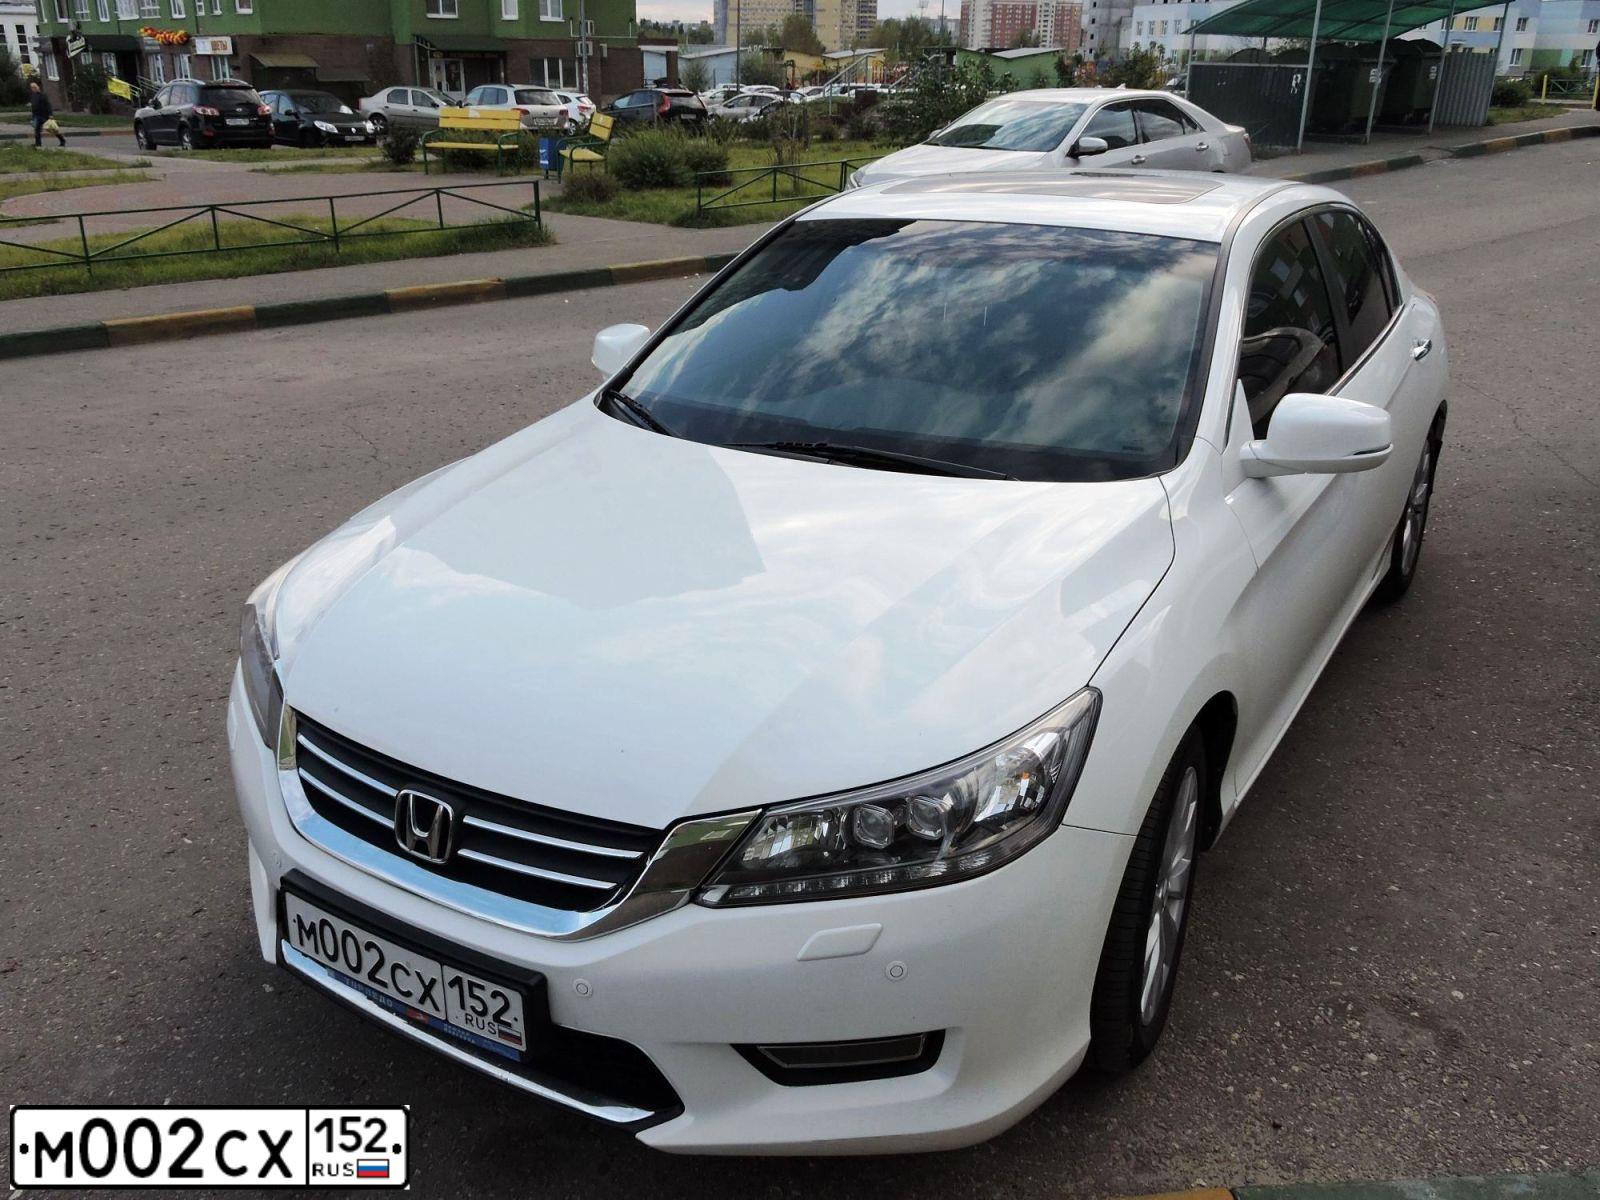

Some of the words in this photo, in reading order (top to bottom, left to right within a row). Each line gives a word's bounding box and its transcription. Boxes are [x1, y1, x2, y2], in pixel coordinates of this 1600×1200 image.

[296, 913, 440, 1012] M002CX
[447, 974, 512, 1028] 152
[464, 1012, 497, 1035] RUS
